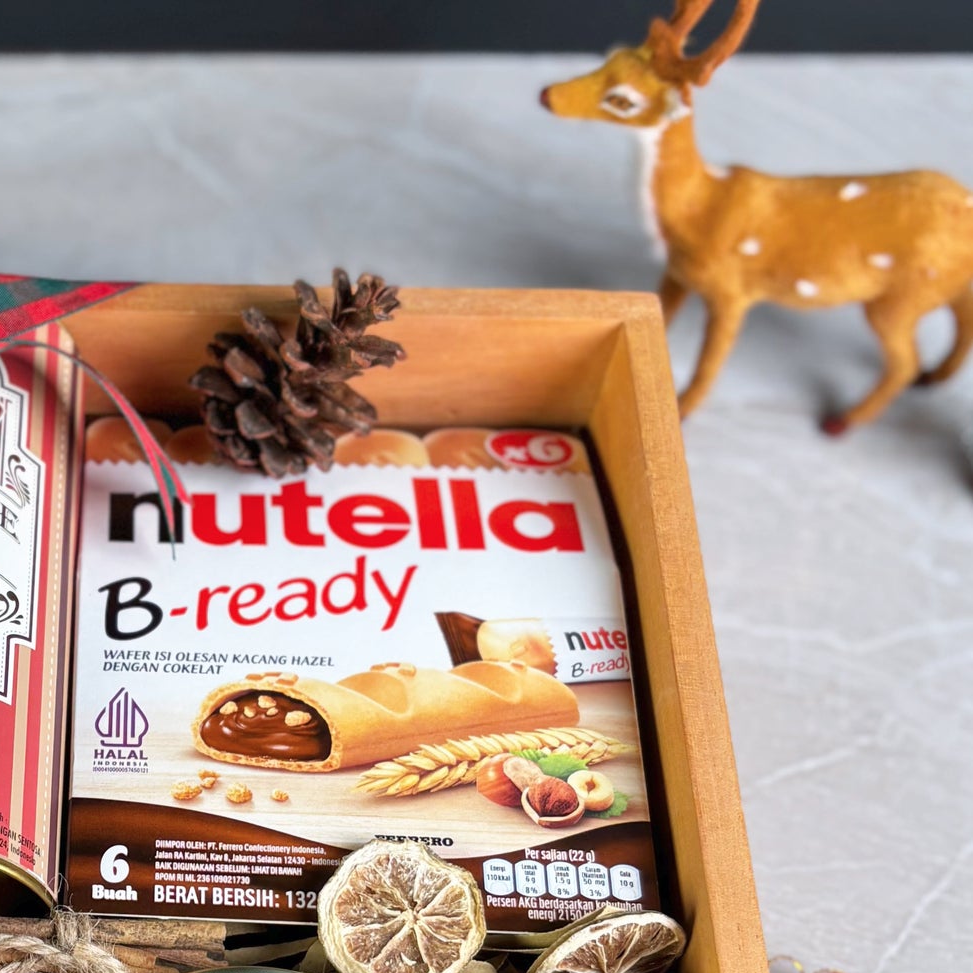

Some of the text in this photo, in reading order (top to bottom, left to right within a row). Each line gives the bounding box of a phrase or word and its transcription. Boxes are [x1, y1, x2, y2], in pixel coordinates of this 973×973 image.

[108, 478, 585, 552] nutella
[97, 555, 419, 642] B-ready
[103, 650, 335, 667] WAFER ISI OLESAN KACANG HAZEL
[103, 661, 224, 675] DENGAN COKELAT
[94, 749, 149, 760] HALAL
[155, 840, 291, 855] DIIMPOR Ferrero Confectionery
[525, 848, 596, 863] Per sajian (22 g)
[100, 845, 130, 884] 6
[172, 862, 215, 872] DIGUNAKAN
[154, 872, 176, 881] BPOM
[92, 885, 138, 901] Buah
[154, 885, 318, 909] BERAT BERSIH: 132
[486, 895, 517, 907] Persen
[518, 896, 538, 908] AKG
[539, 898, 594, 910] berdasarkan
[528, 909, 582, 922] energi 2150
